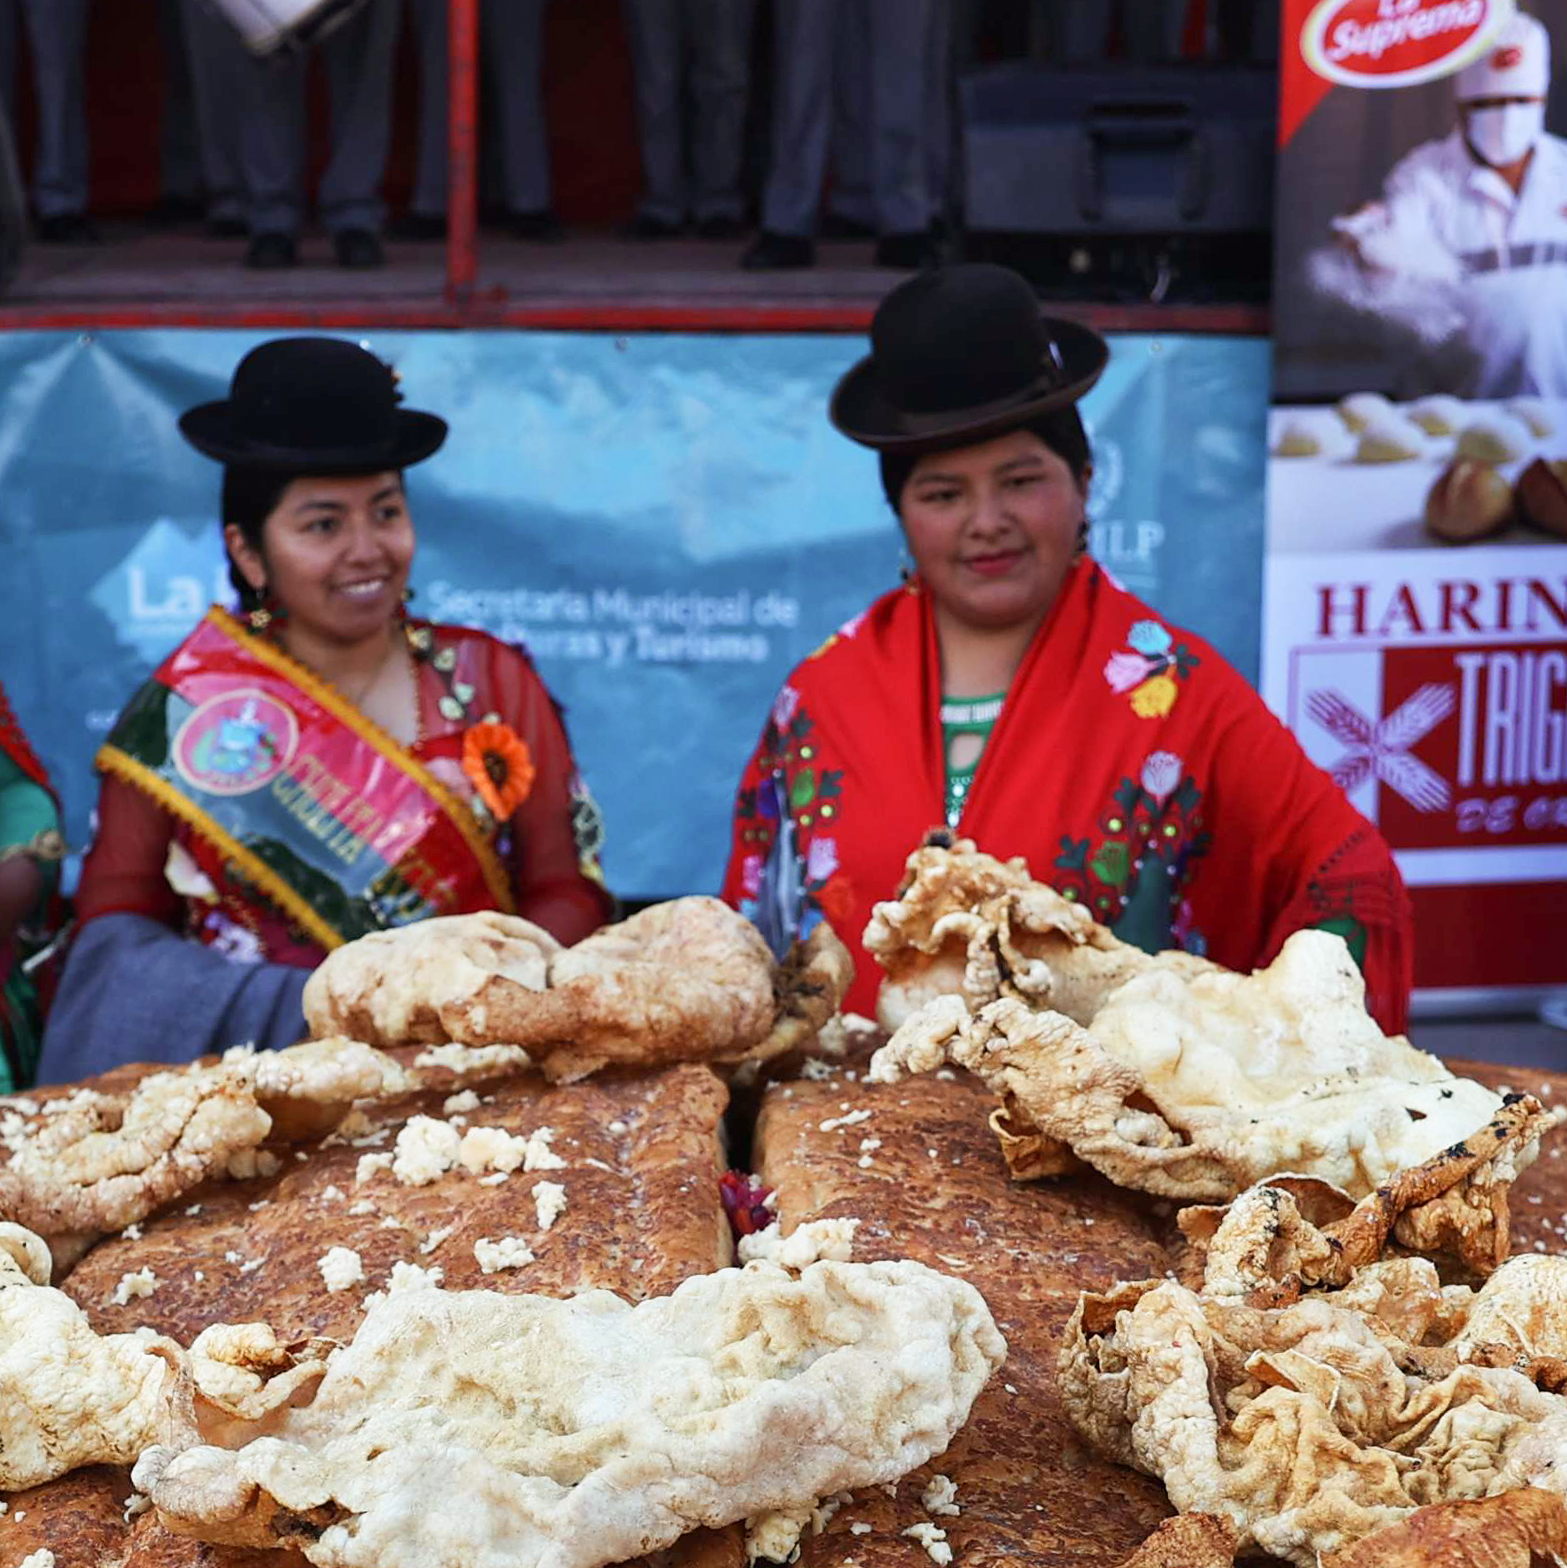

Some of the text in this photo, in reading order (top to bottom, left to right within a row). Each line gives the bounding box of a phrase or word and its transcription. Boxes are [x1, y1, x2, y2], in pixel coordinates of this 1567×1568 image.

[1325, 1, 1484, 62] Suprema
[126, 565, 205, 619] La
[593, 587, 749, 629] Municipal
[753, 591, 800, 628] de
[604, 632, 628, 668] y
[634, 625, 770, 664] Turismo
[1455, 796, 1519, 835] DE
